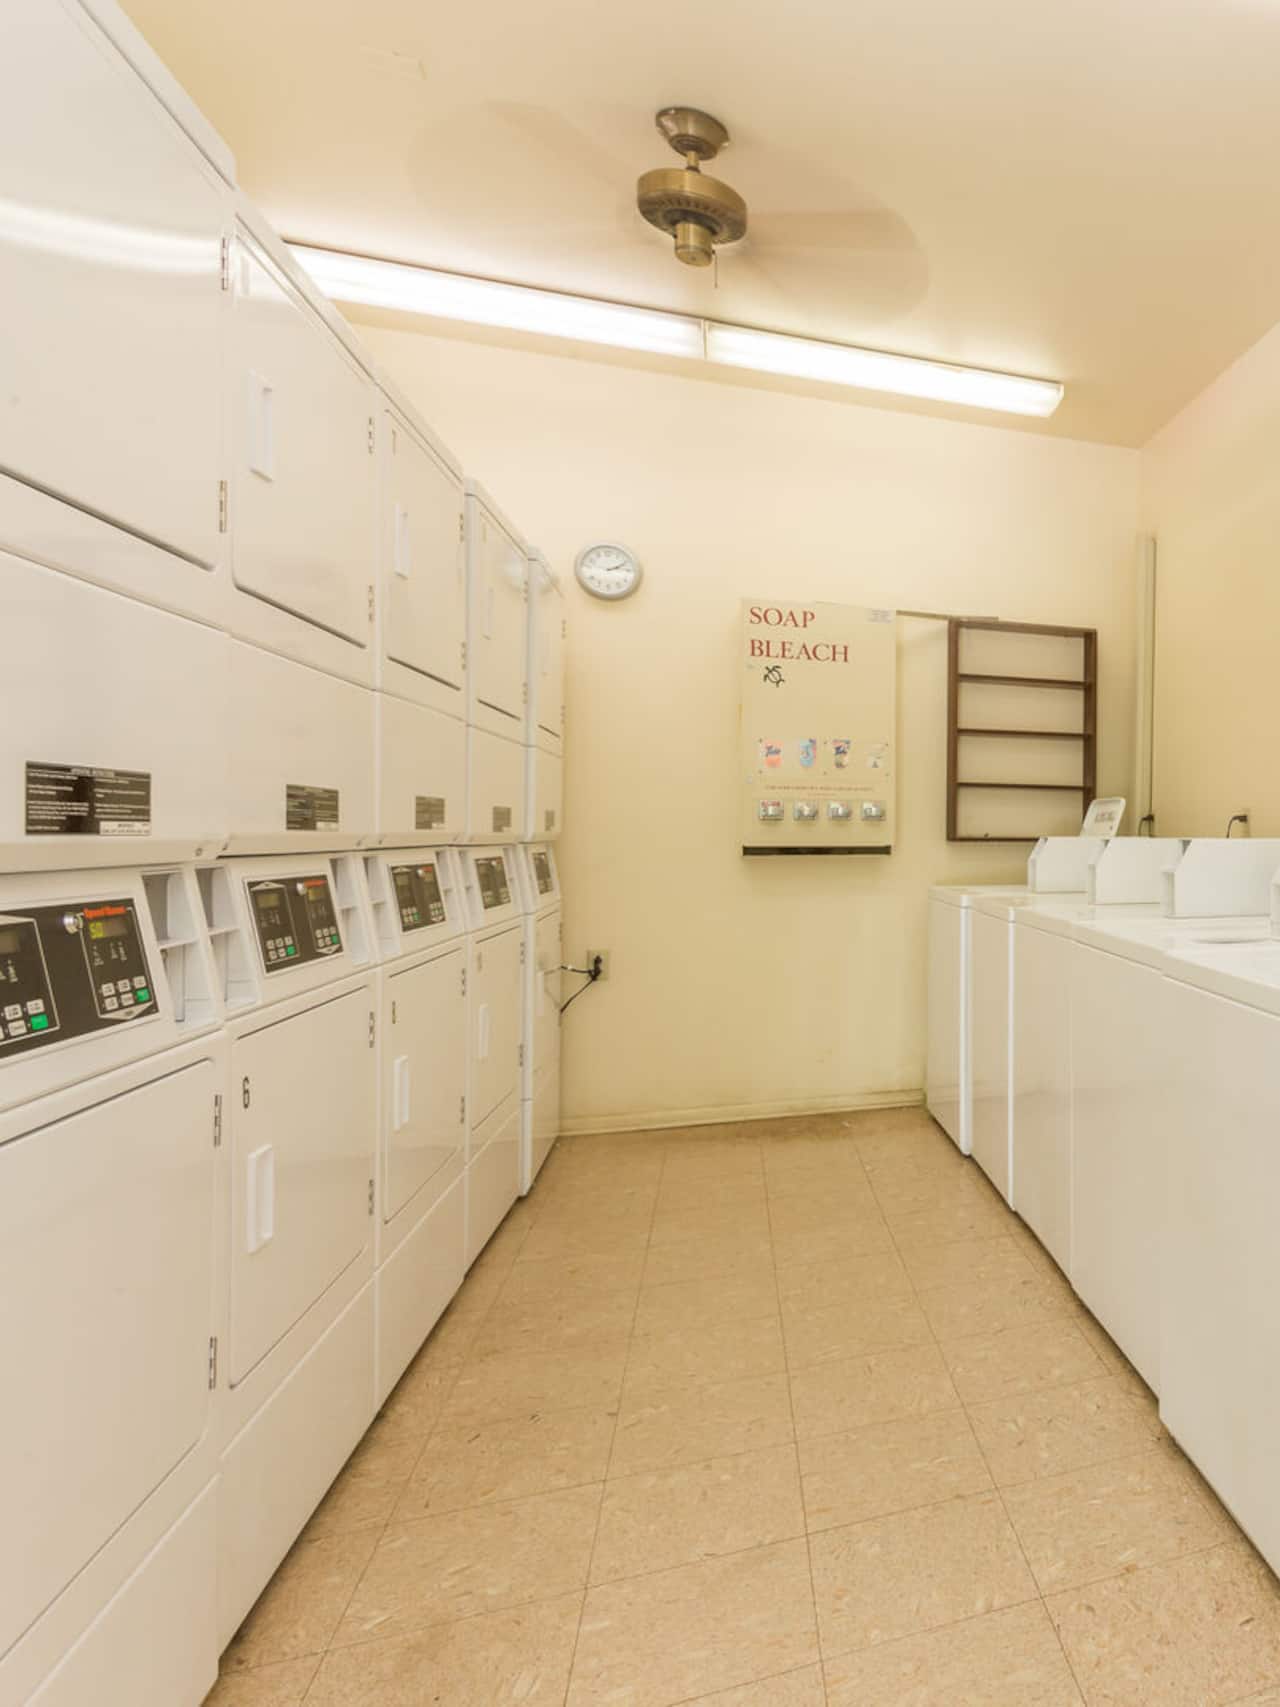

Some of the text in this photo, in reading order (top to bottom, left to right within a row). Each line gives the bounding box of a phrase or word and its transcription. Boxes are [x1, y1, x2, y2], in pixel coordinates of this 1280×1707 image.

[749, 606, 816, 628] SOAP
[749, 639, 849, 663] BLEACH
[242, 1076, 250, 1109] 6
